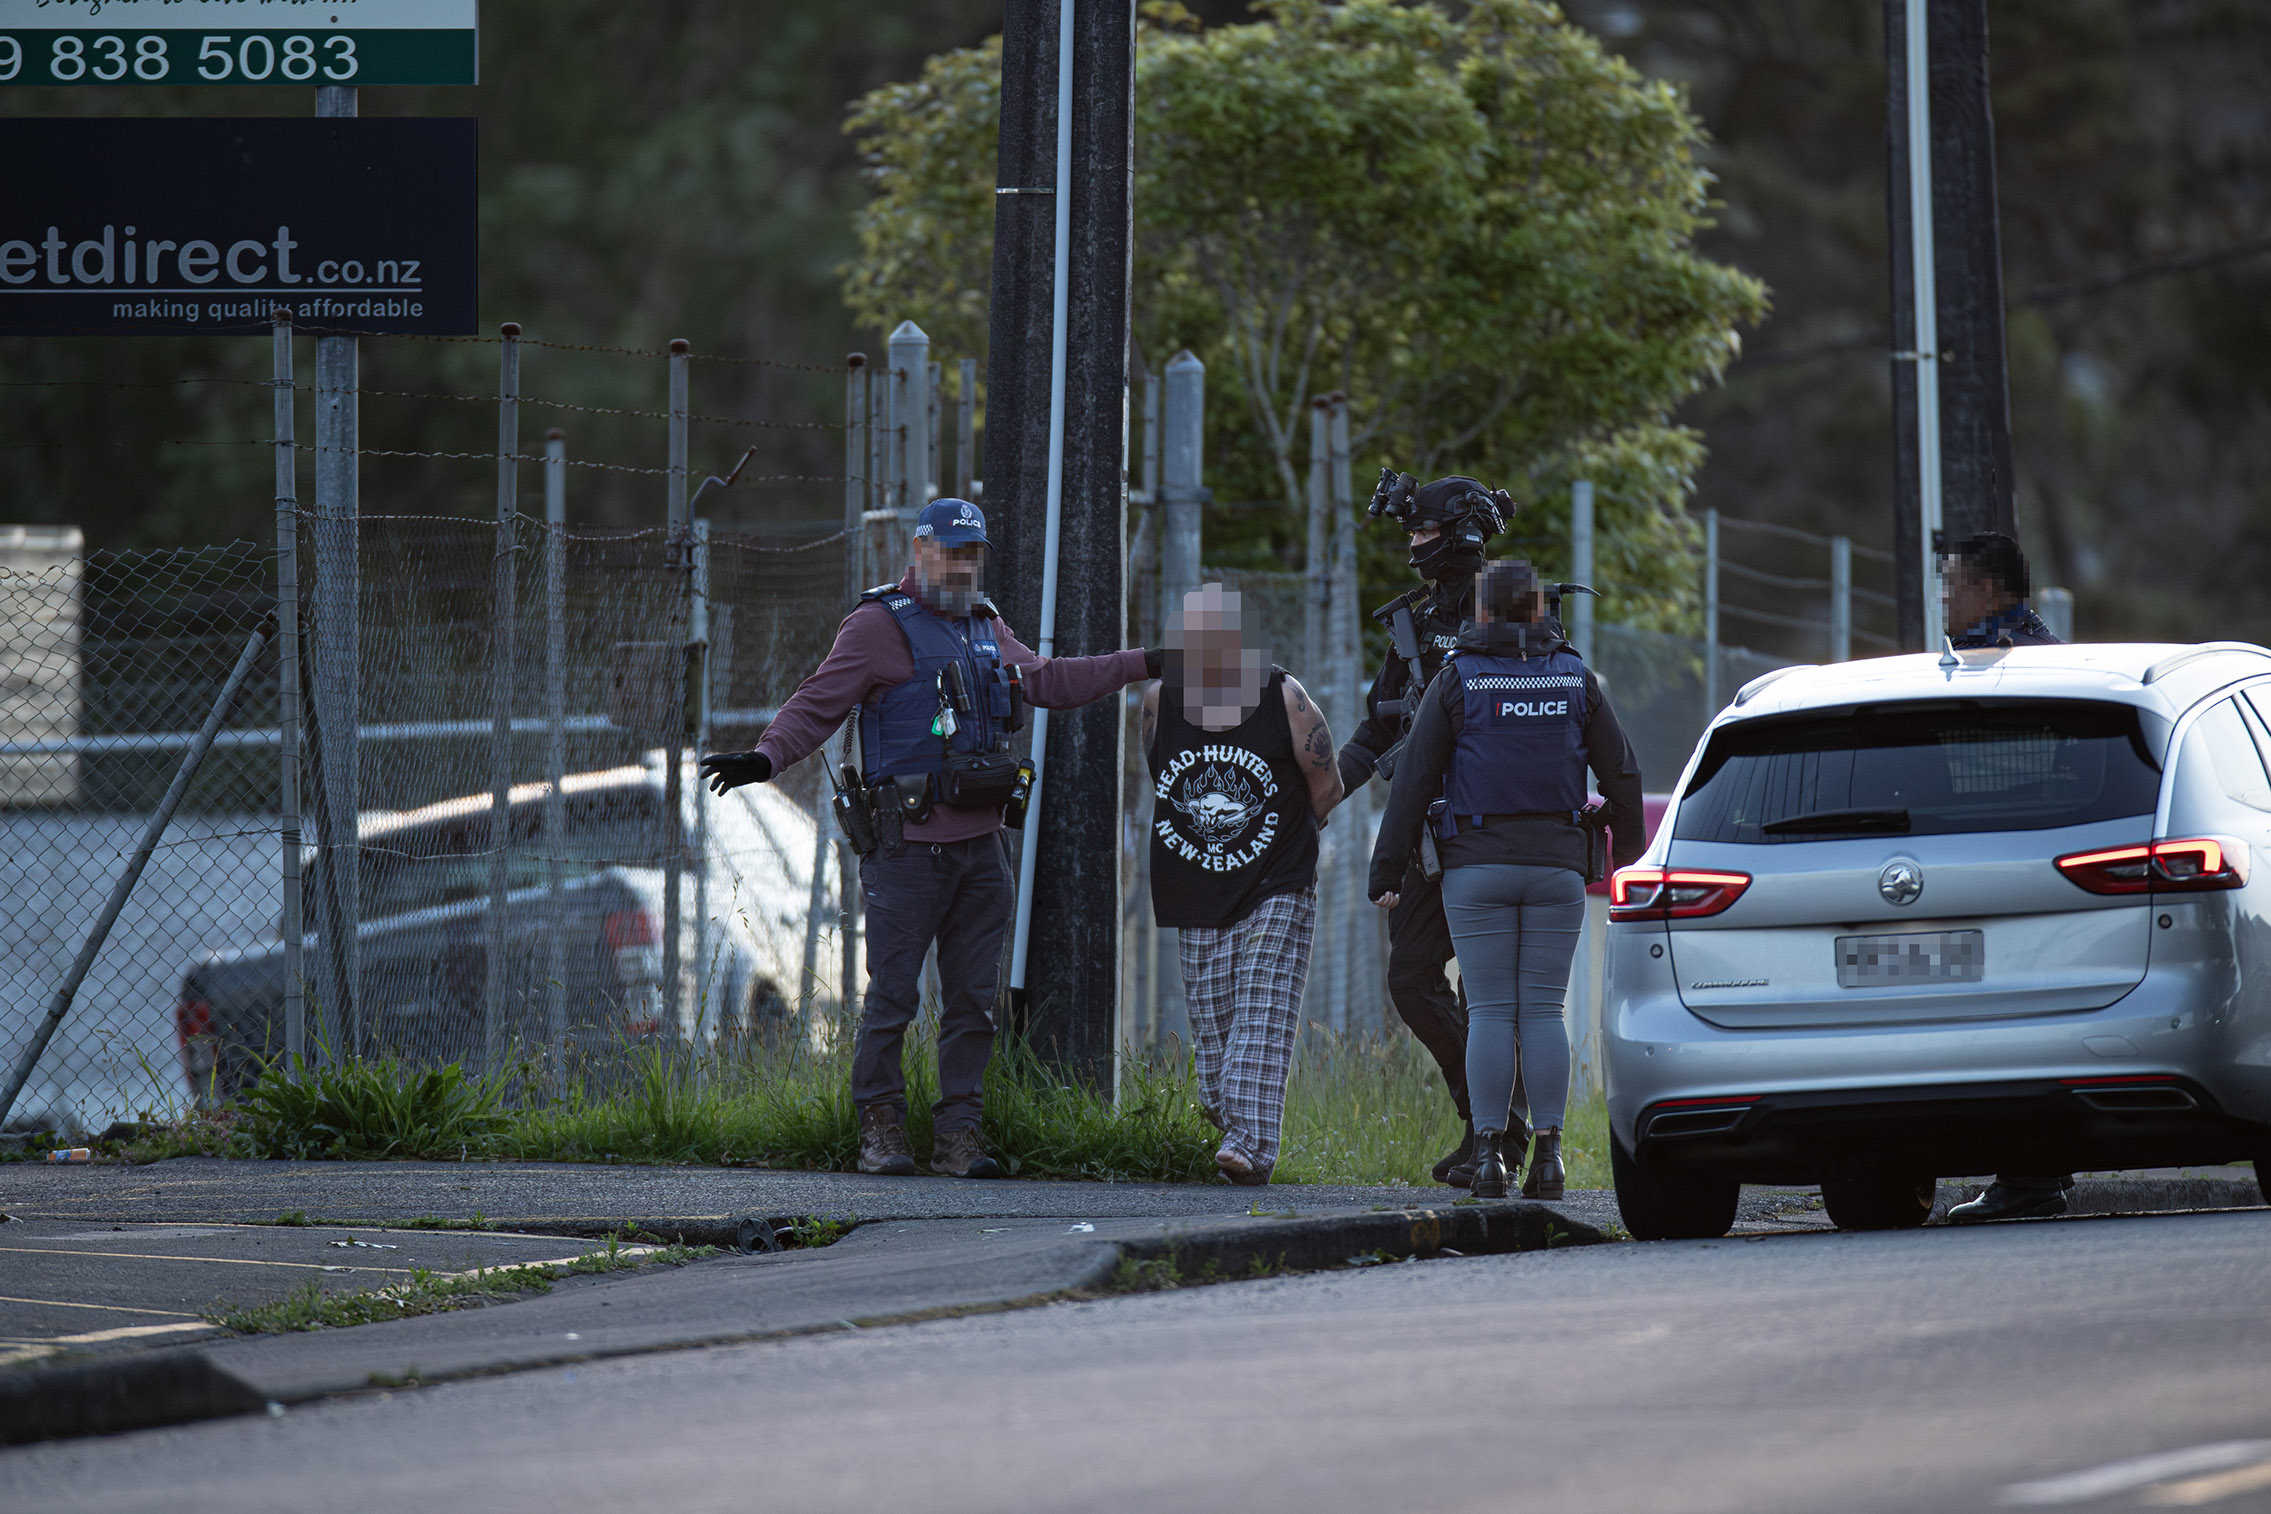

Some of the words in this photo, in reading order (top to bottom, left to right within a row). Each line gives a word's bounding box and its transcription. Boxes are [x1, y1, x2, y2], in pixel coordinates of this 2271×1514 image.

[49, 35, 170, 81] 838
[197, 35, 359, 81] 5083
[113, 298, 200, 321] making
[298, 298, 423, 318] affordable
[952, 518, 981, 528] POLICE
[1432, 634, 1457, 648] POLIC
[1501, 700, 1568, 717] POLICE
[1155, 818, 1199, 862] NEW
[1201, 811, 1279, 872] ZEALAND
[1207, 842, 1224, 854] MC
